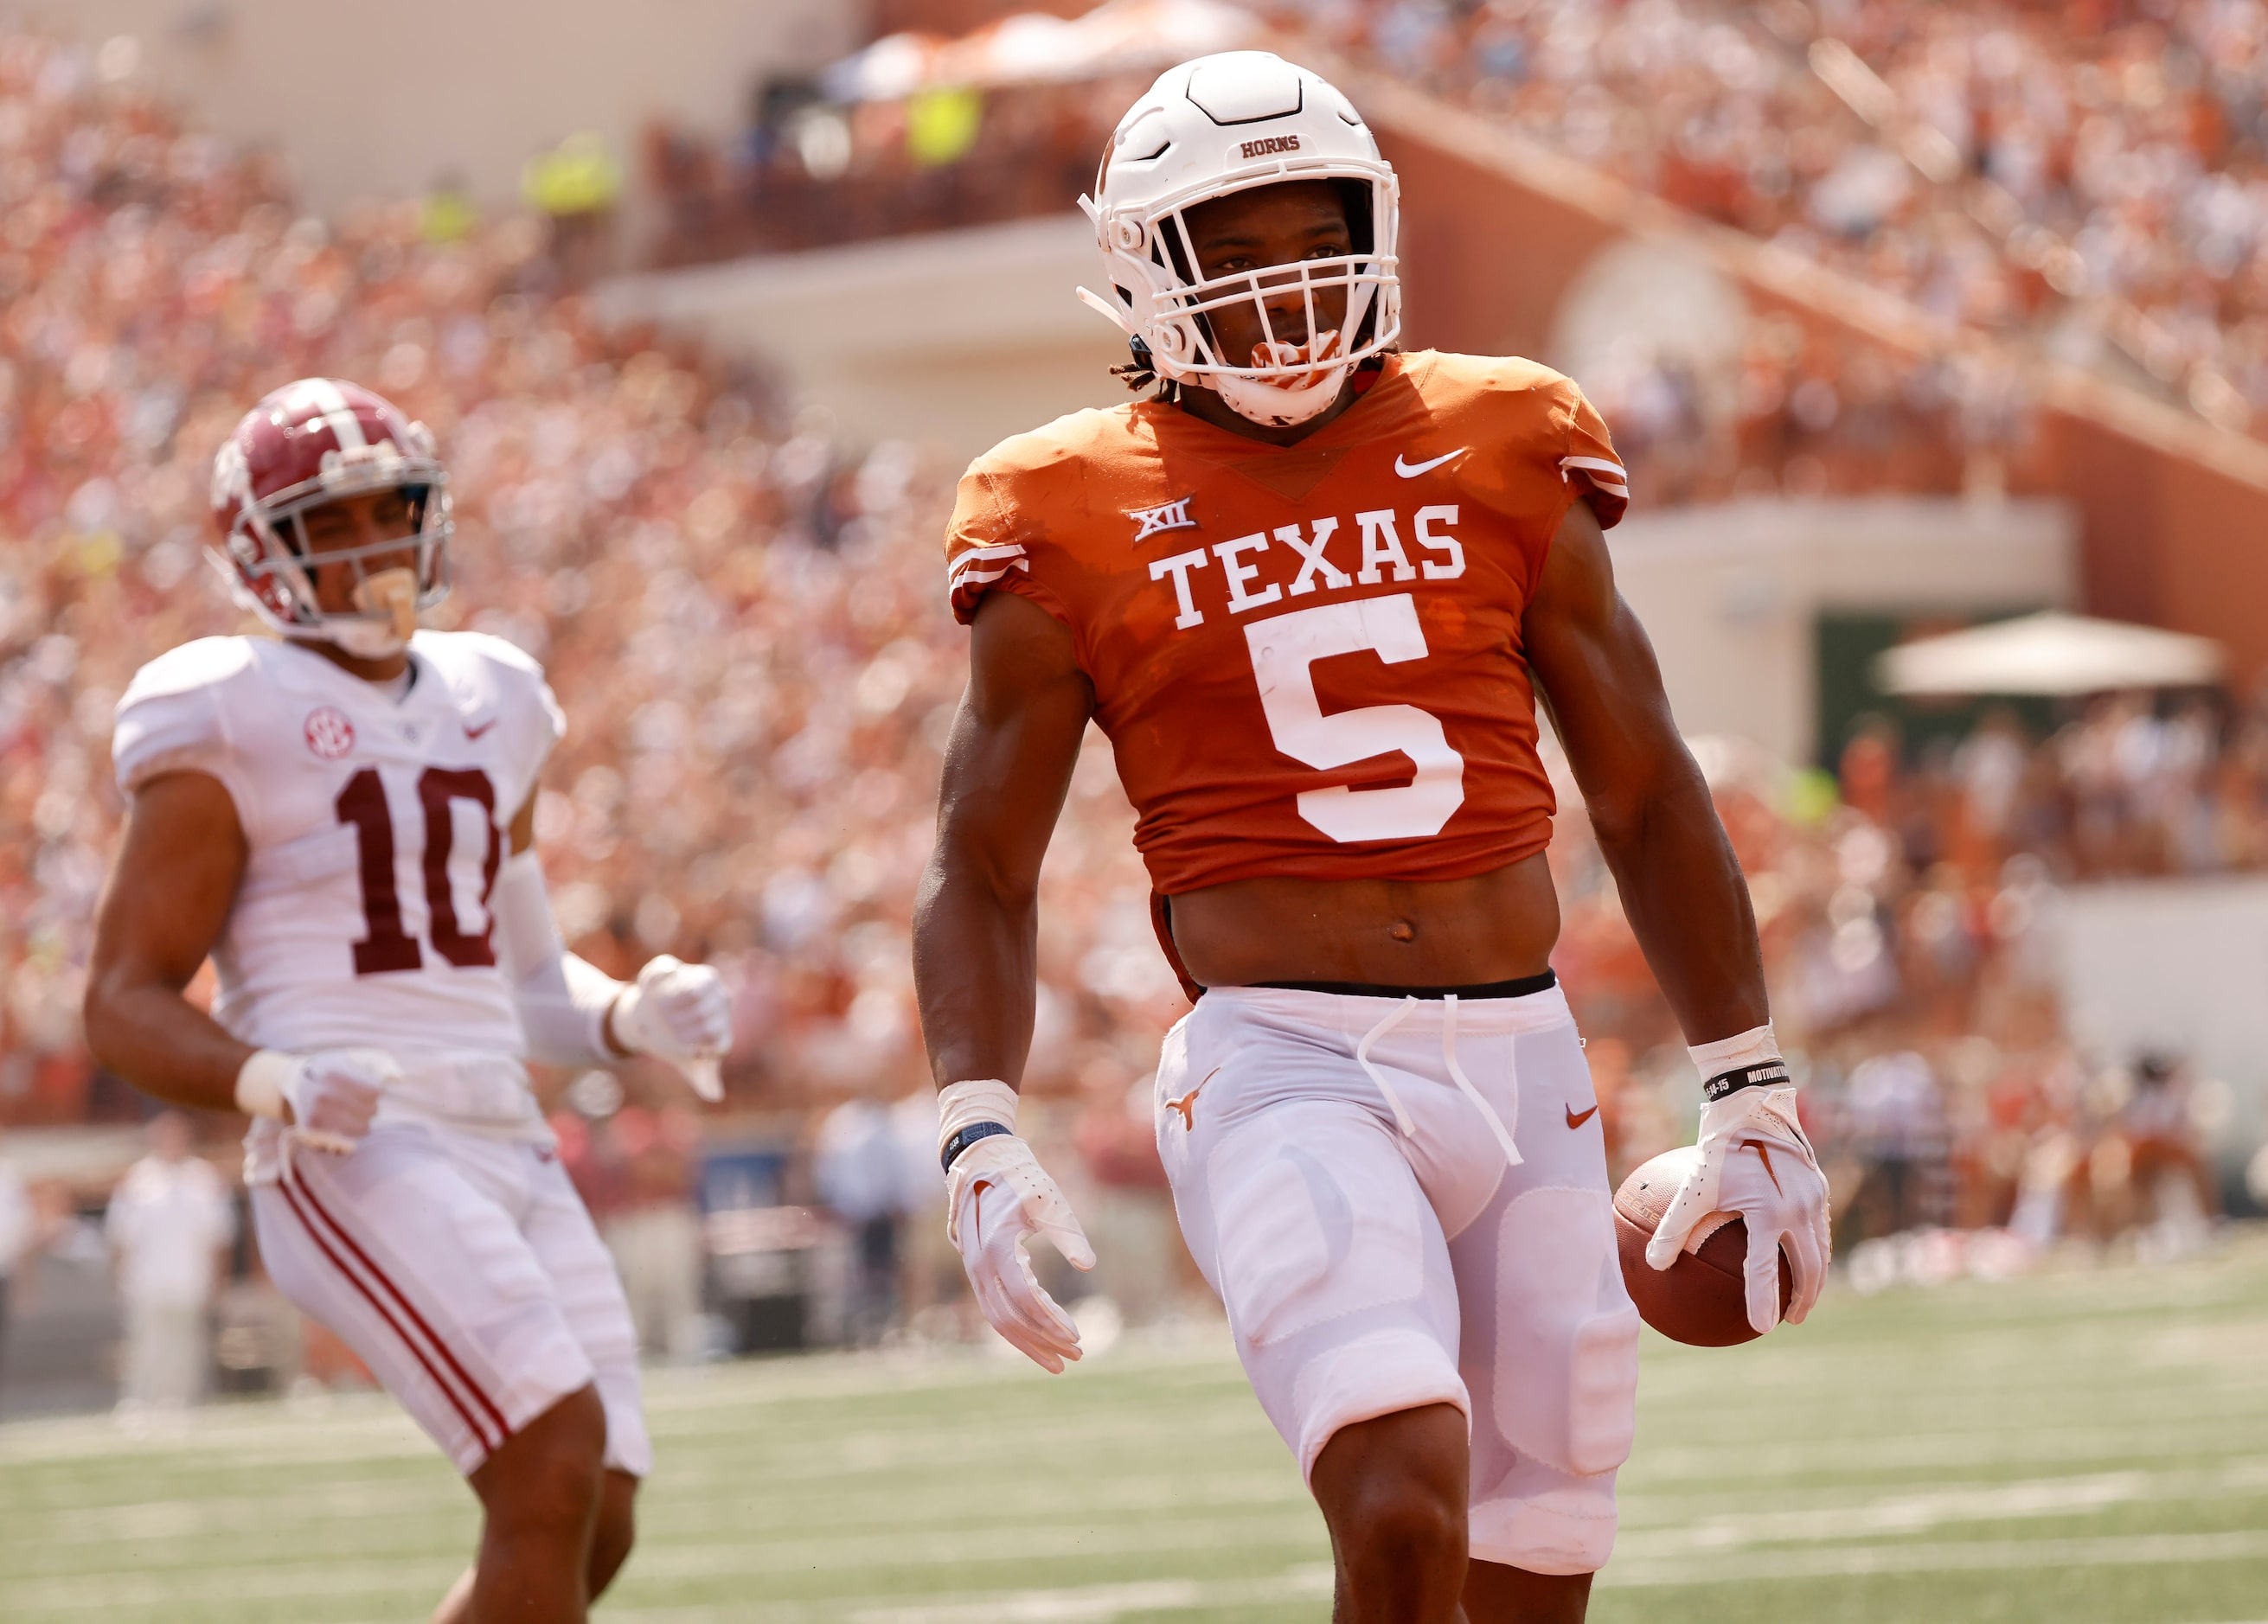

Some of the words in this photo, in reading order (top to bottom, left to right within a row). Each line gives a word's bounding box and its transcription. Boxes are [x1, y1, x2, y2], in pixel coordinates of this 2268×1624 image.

[1240, 135, 1300, 158] HORNS
[1148, 505, 1467, 630] TEXAS
[1243, 592, 1465, 843] 5
[335, 765, 501, 974] 10
